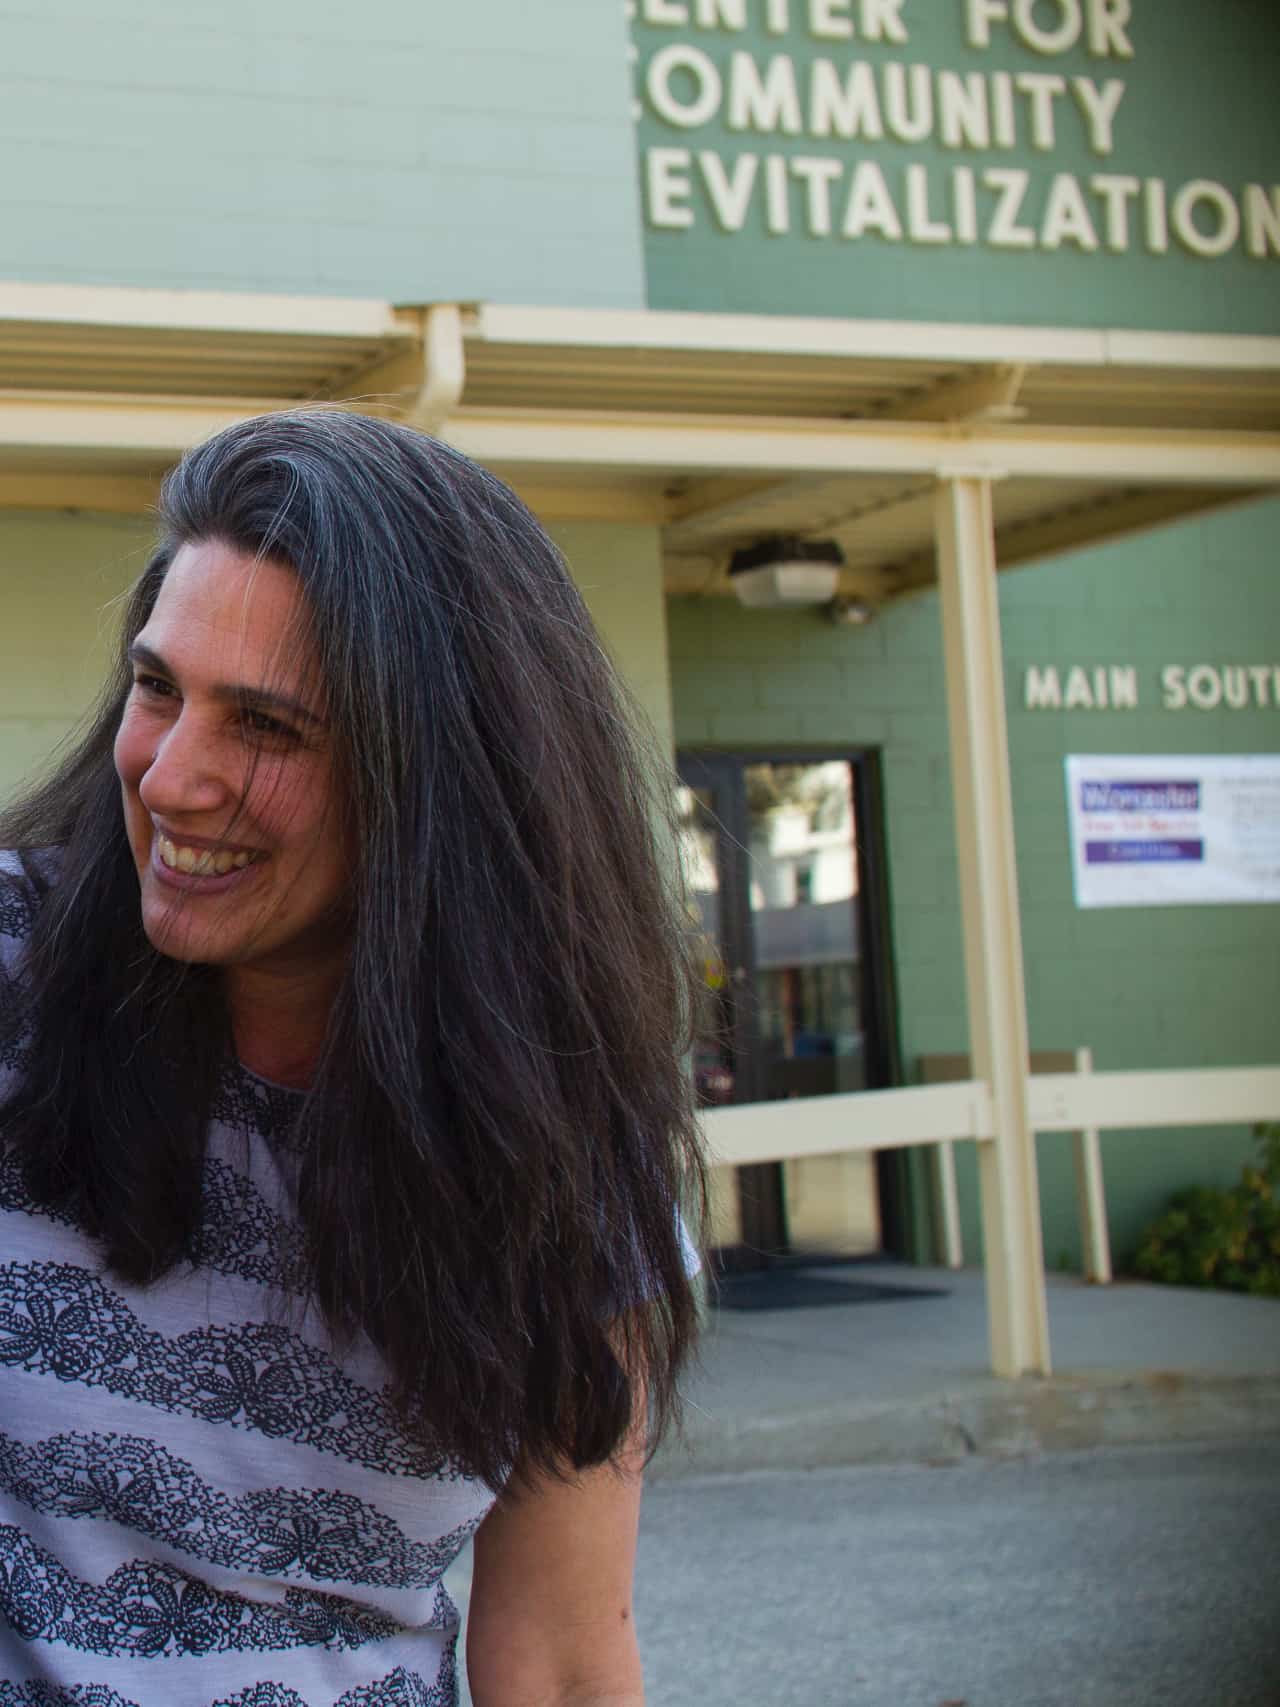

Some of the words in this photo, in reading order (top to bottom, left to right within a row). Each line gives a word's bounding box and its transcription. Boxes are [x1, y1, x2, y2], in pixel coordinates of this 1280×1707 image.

[967, 0, 1134, 57] FOR
[625, 44, 1125, 152] OMMUNITY
[646, 147, 1280, 256] EVITALIZATION
[1026, 664, 1138, 709] MAIN
[1162, 664, 1280, 709] SOUT
